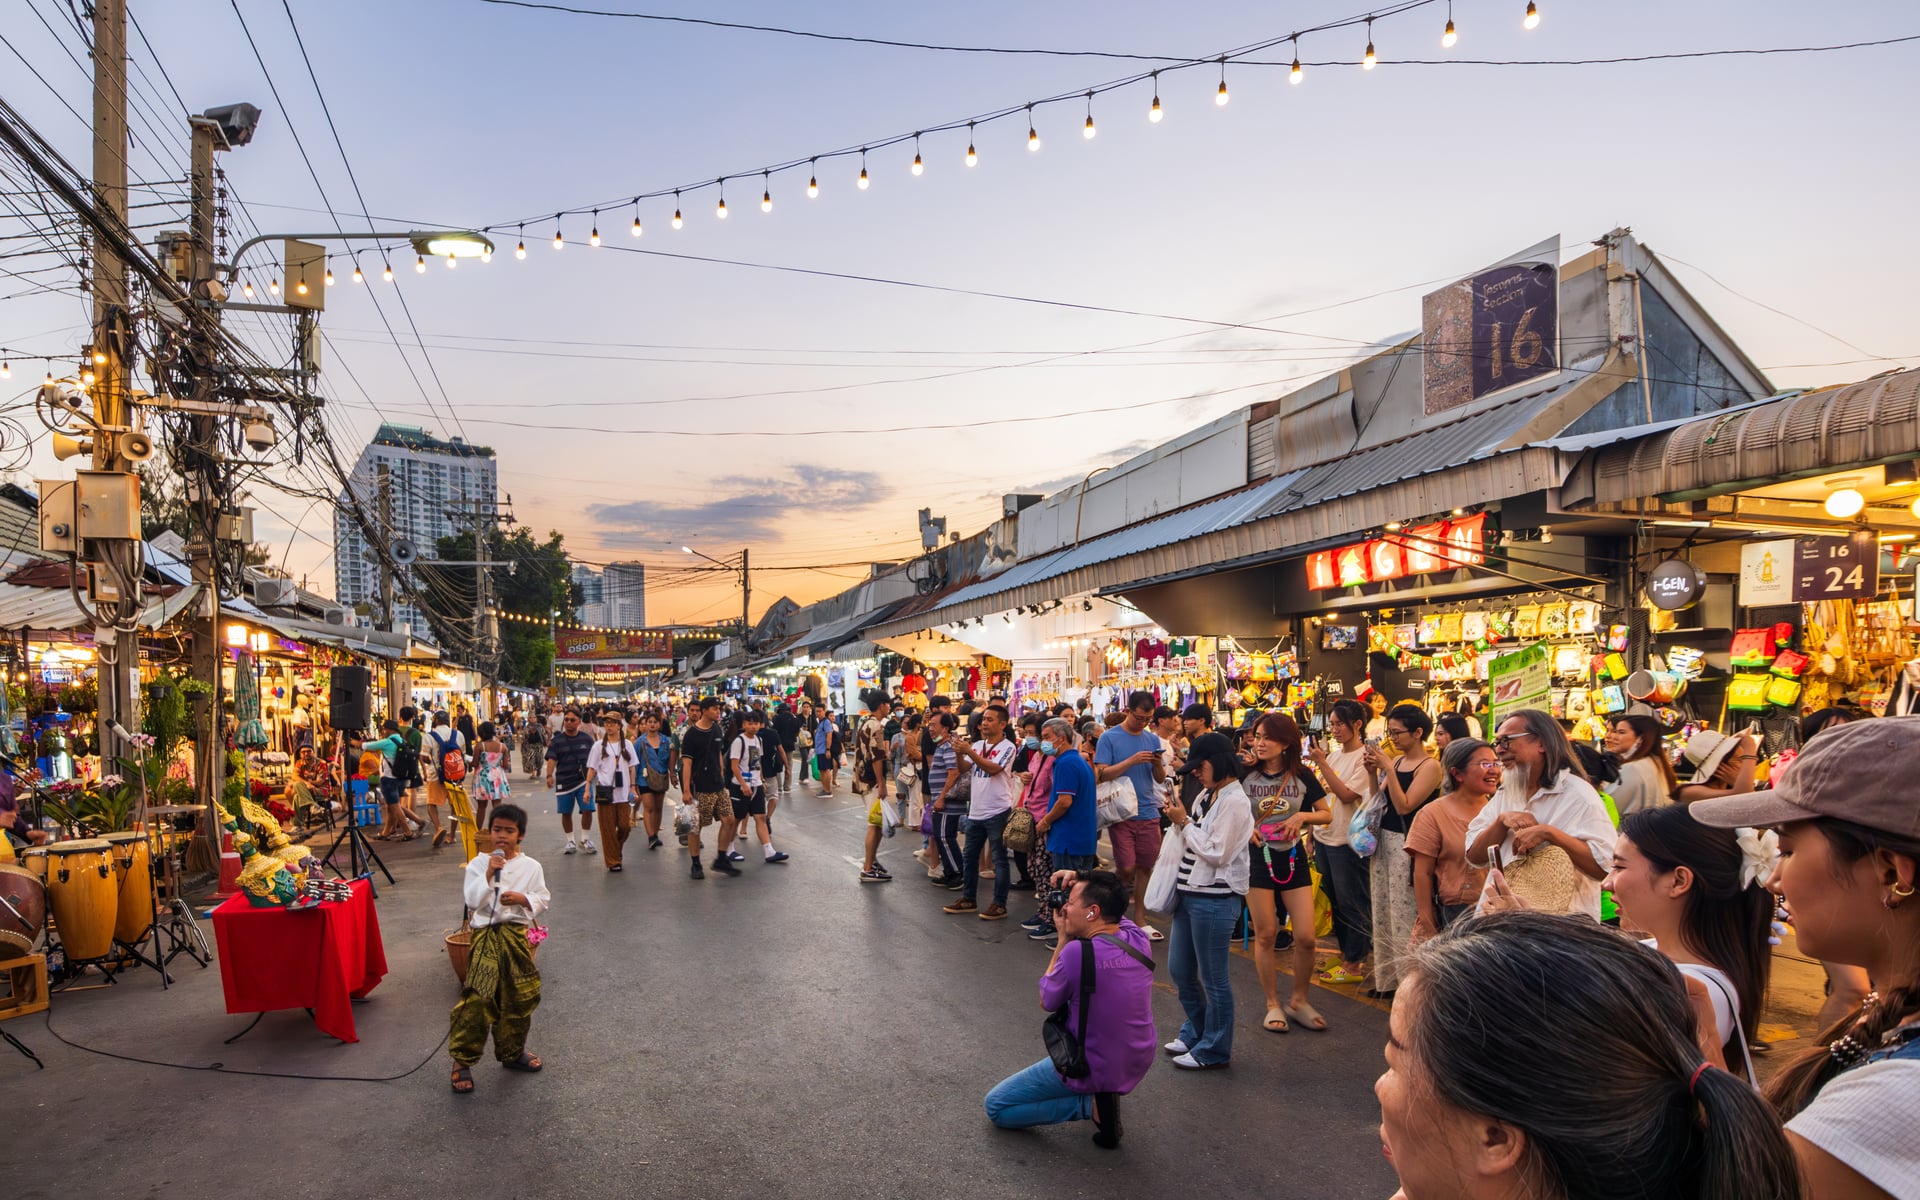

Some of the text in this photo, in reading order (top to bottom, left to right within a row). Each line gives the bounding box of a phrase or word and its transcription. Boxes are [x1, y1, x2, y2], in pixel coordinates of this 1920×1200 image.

[1491, 306, 1543, 379] 16
[1829, 544, 1849, 558] 16
[1824, 563, 1865, 592] 24
[1368, 628, 1410, 662] MERRY
[1327, 682, 1341, 693] 290
